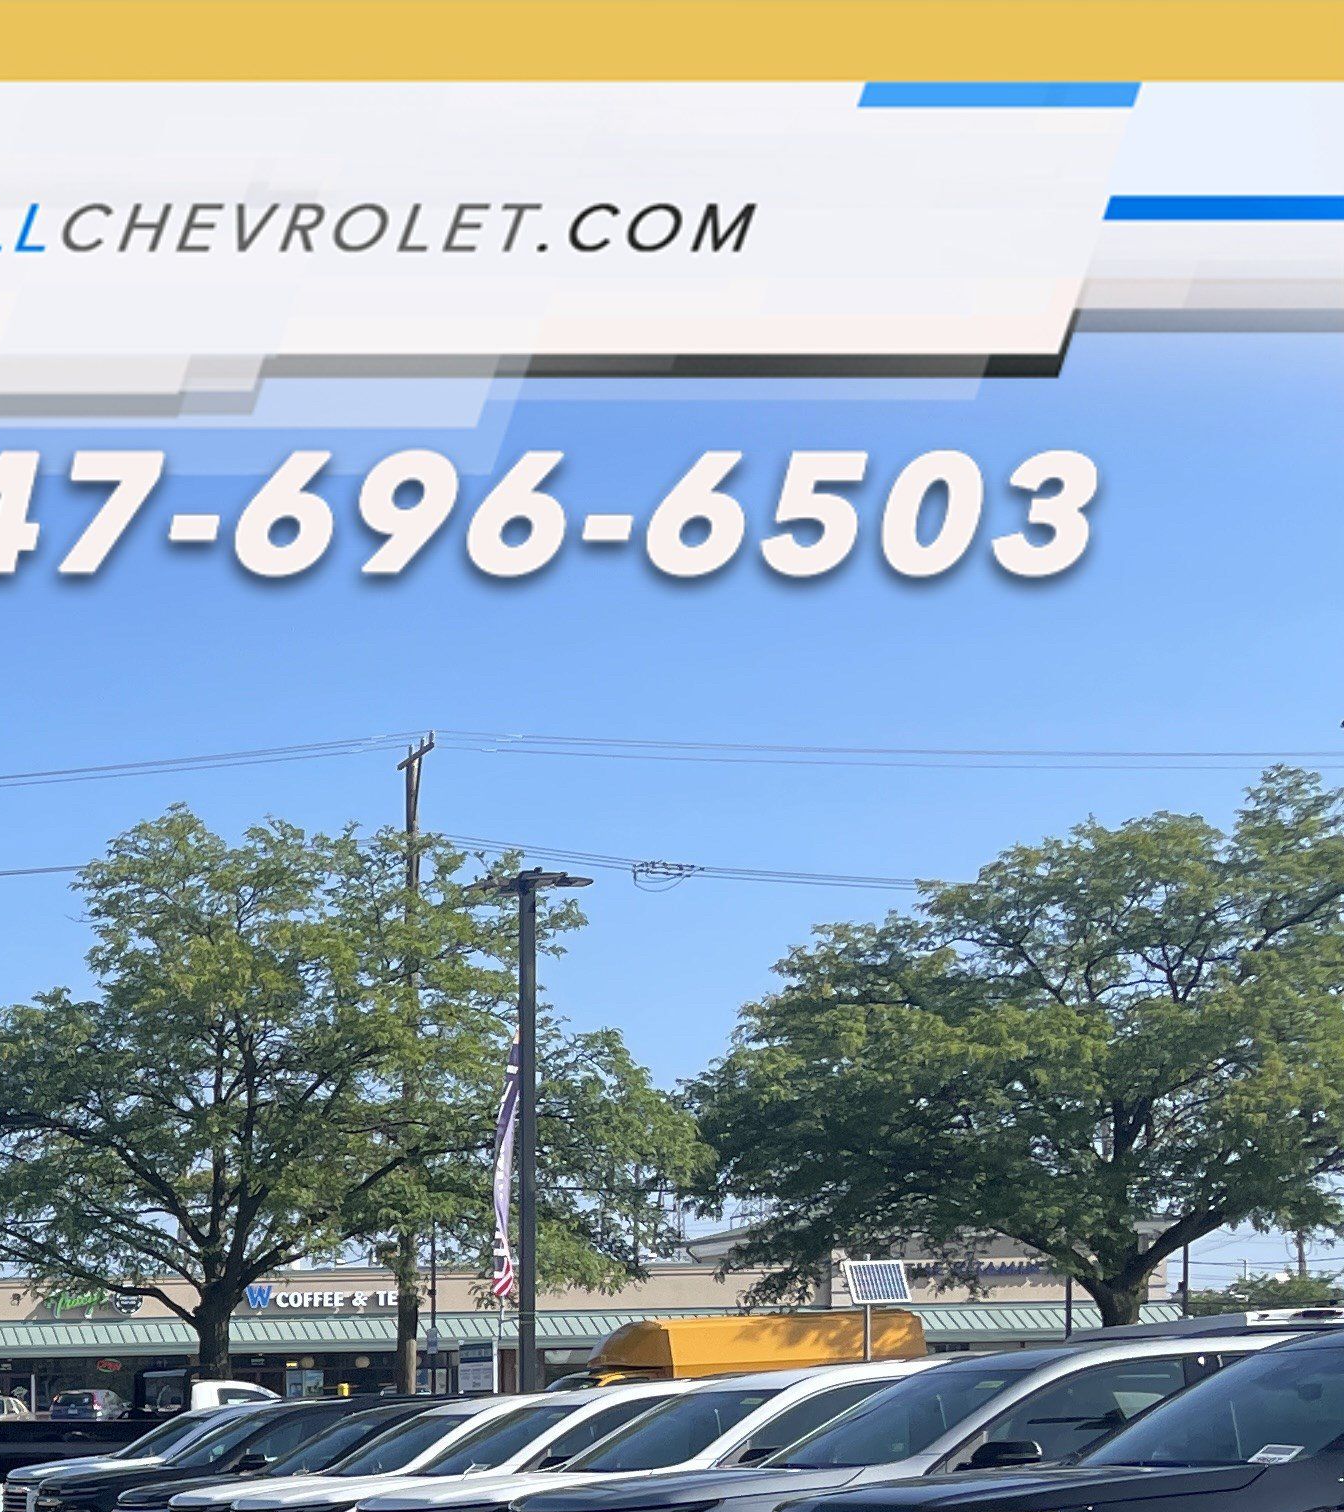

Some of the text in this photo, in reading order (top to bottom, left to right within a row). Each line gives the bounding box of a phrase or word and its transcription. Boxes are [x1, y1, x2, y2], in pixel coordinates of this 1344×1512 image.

[275, 1291, 345, 1308] COFFEE
[350, 1291, 368, 1307] &
[375, 1291, 399, 1306] TE
